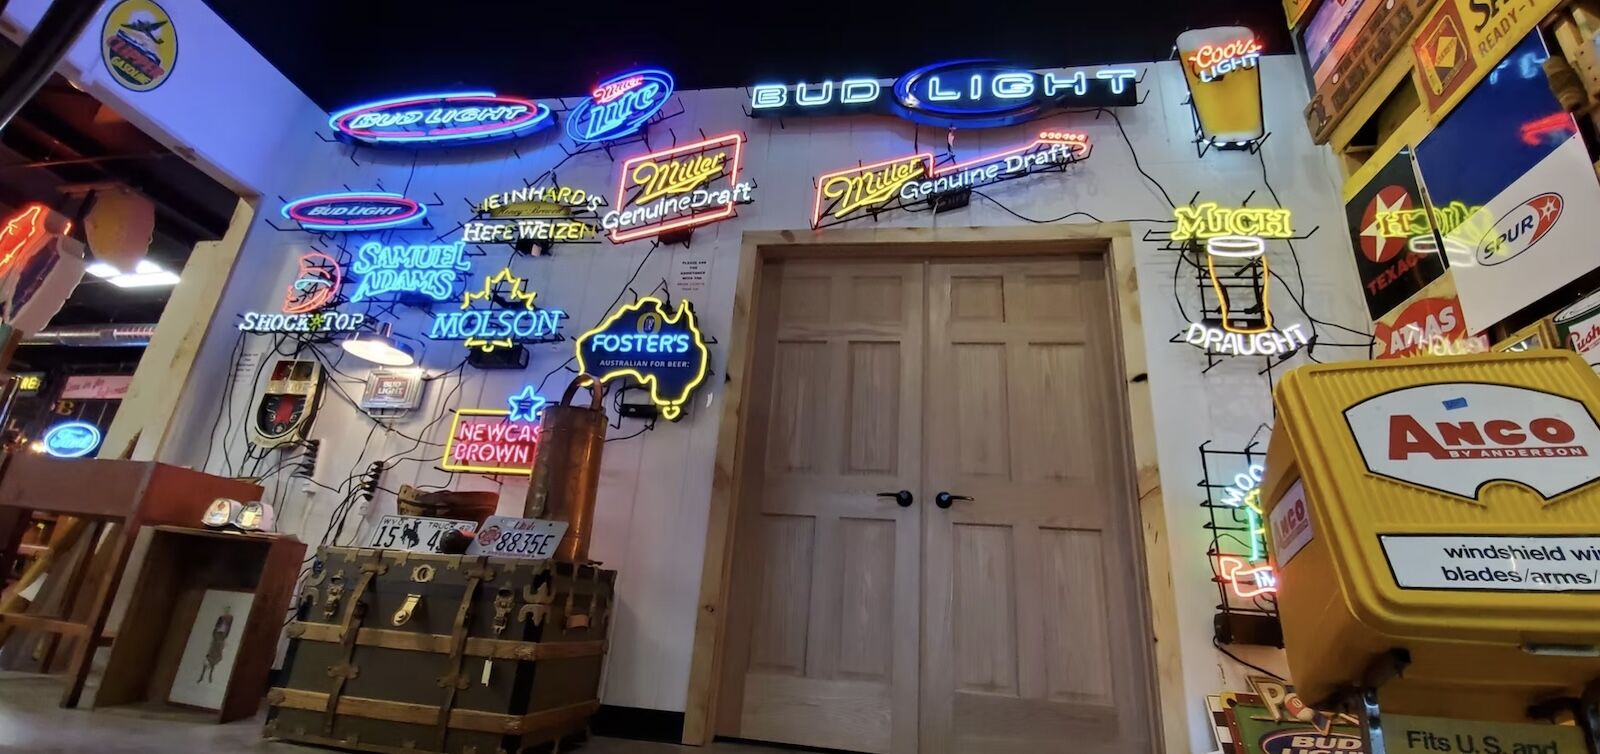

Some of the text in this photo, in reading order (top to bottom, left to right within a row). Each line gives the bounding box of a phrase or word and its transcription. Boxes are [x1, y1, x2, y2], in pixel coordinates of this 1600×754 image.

[1189, 39, 1262, 68] Coors
[1200, 53, 1259, 82] LIGHT
[752, 69, 1137, 109] BUD LIGHT
[350, 106, 527, 128] BUD LIGHT
[632, 152, 726, 203] Miller
[900, 143, 1071, 200] Genuine Draft
[824, 158, 924, 218] Miller
[308, 205, 402, 215] BUD LIGHT
[602, 182, 751, 229] Genuine Draft
[462, 221, 596, 241] HEFE WEIZEN
[1171, 203, 1293, 240] MICH
[1483, 215, 1534, 260] SPUR
[353, 241, 471, 274] SAMUEL
[351, 269, 456, 303] ADAMS
[239, 312, 364, 331] SHOCK TOP
[430, 310, 566, 338] MOLSON
[592, 334, 690, 353] FOSTER'S
[1186, 323, 1309, 355] DRAUGHT
[454, 443, 529, 464] BROWN
[1449, 448, 1584, 459] BY ANDERSON
[373, 525, 400, 547] 15
[496, 532, 555, 555] 8835E
[1443, 545, 1600, 561] windshield wi
[1291, 736, 1362, 750] BUD
[1406, 730, 1451, 751] Fits
